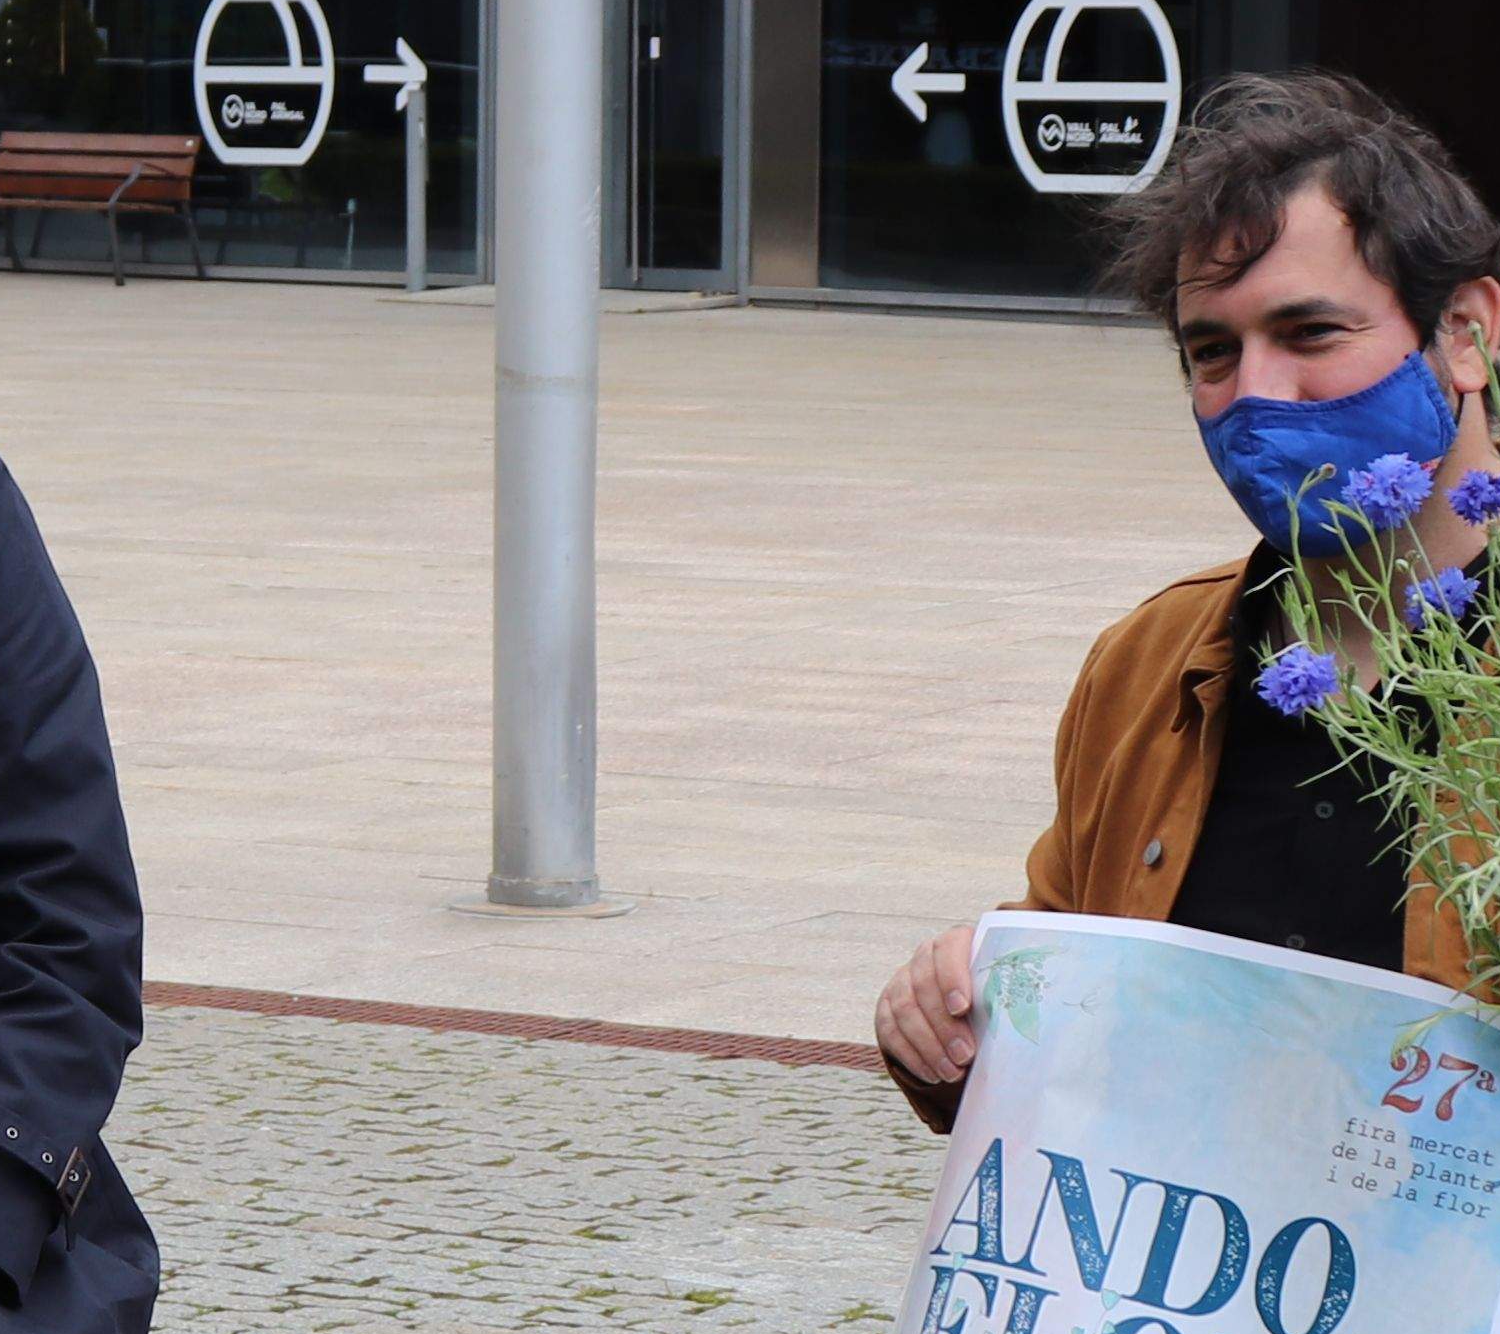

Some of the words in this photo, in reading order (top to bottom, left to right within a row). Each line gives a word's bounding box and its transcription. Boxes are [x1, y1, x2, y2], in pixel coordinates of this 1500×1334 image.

[1332, 1142, 1357, 1161] de
[1371, 1149, 1396, 1170] la
[1411, 1160, 1496, 1194] planta
[1344, 1117, 1396, 1143] fira
[1410, 1134, 1496, 1167] mercat
[1326, 1166, 1337, 1184] i
[1351, 1172, 1378, 1192] de
[1393, 1181, 1417, 1202] la
[1433, 1192, 1493, 1219] flor
